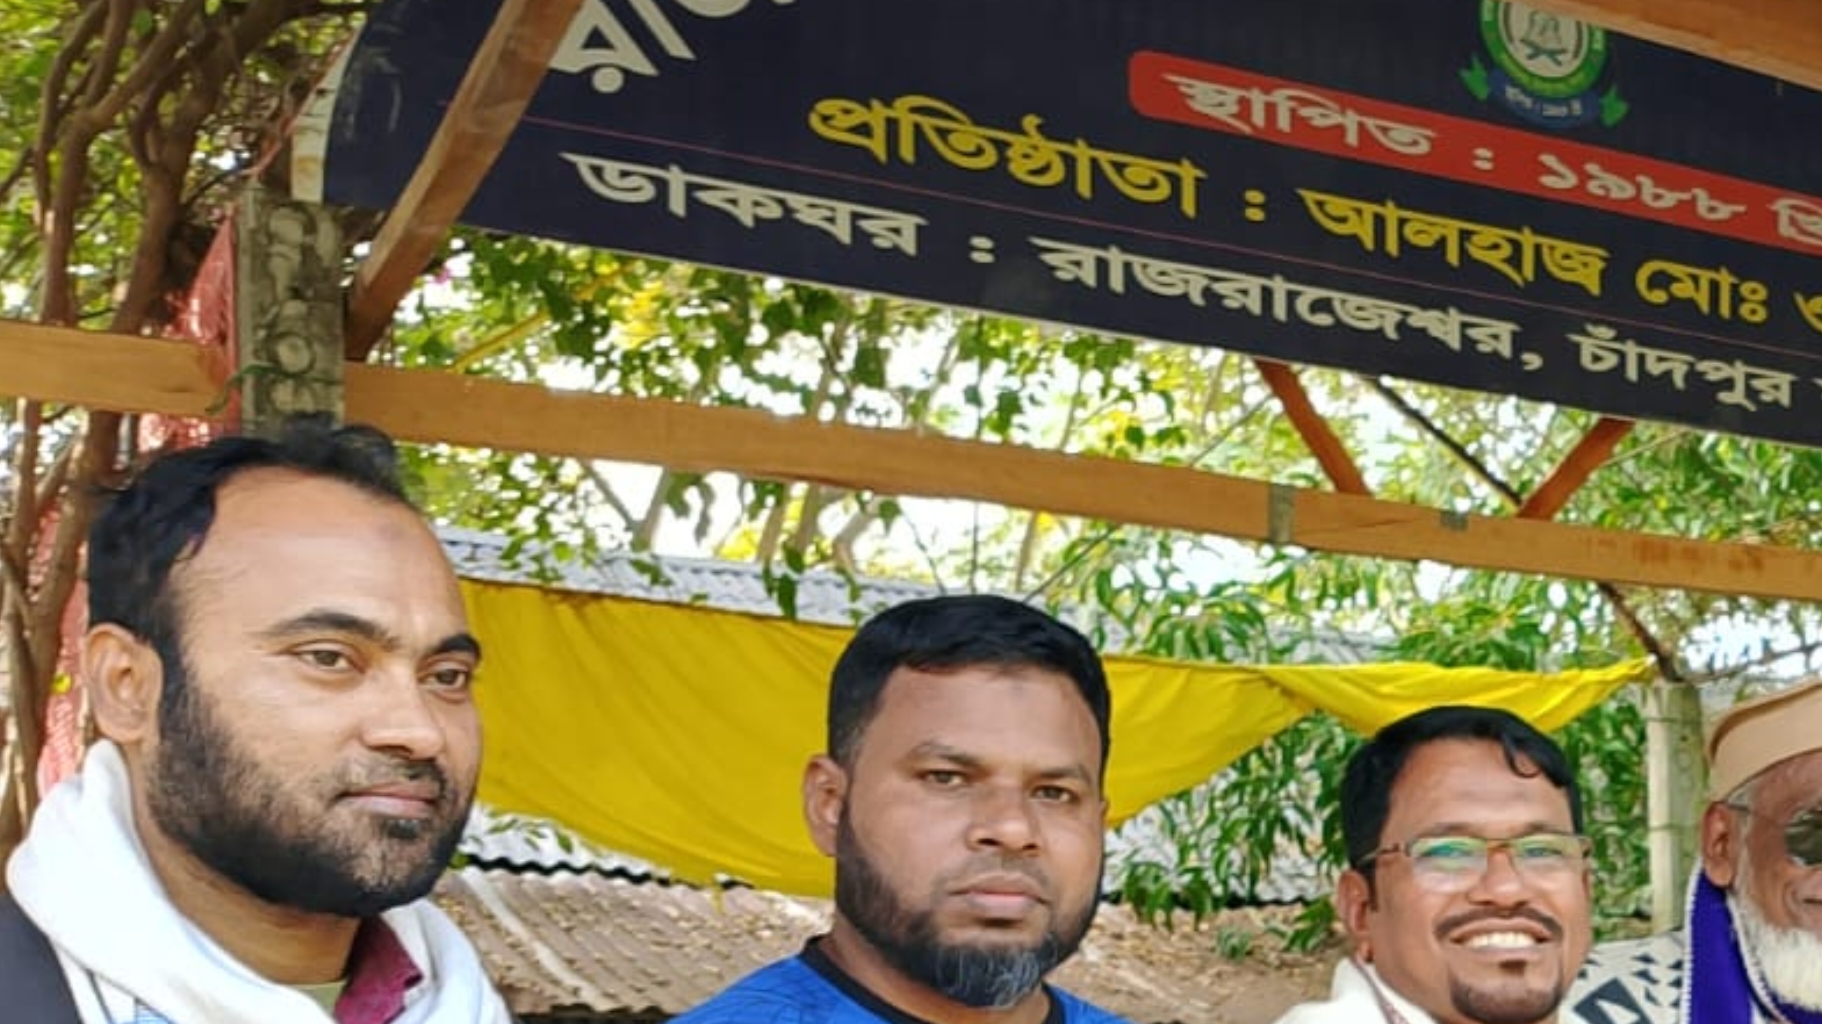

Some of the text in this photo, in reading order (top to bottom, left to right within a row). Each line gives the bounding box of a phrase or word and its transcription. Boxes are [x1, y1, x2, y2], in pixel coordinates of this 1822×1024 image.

[808, 94, 1208, 219] প্রতিষ্ঠাতা
[1243, 189, 1267, 222] :
[1634, 259, 1768, 323] মোঃ
[1164, 73, 1436, 156] স্থাপিত
[1472, 146, 1495, 171] :
[1538, 152, 1748, 222] ১৯৮৮
[559, 151, 929, 257] ডাকঘর
[968, 235, 997, 264] :
[1028, 236, 1545, 372] রাজরাজেশ্বর,
[1565, 322, 1799, 412] চাঁদপুর
